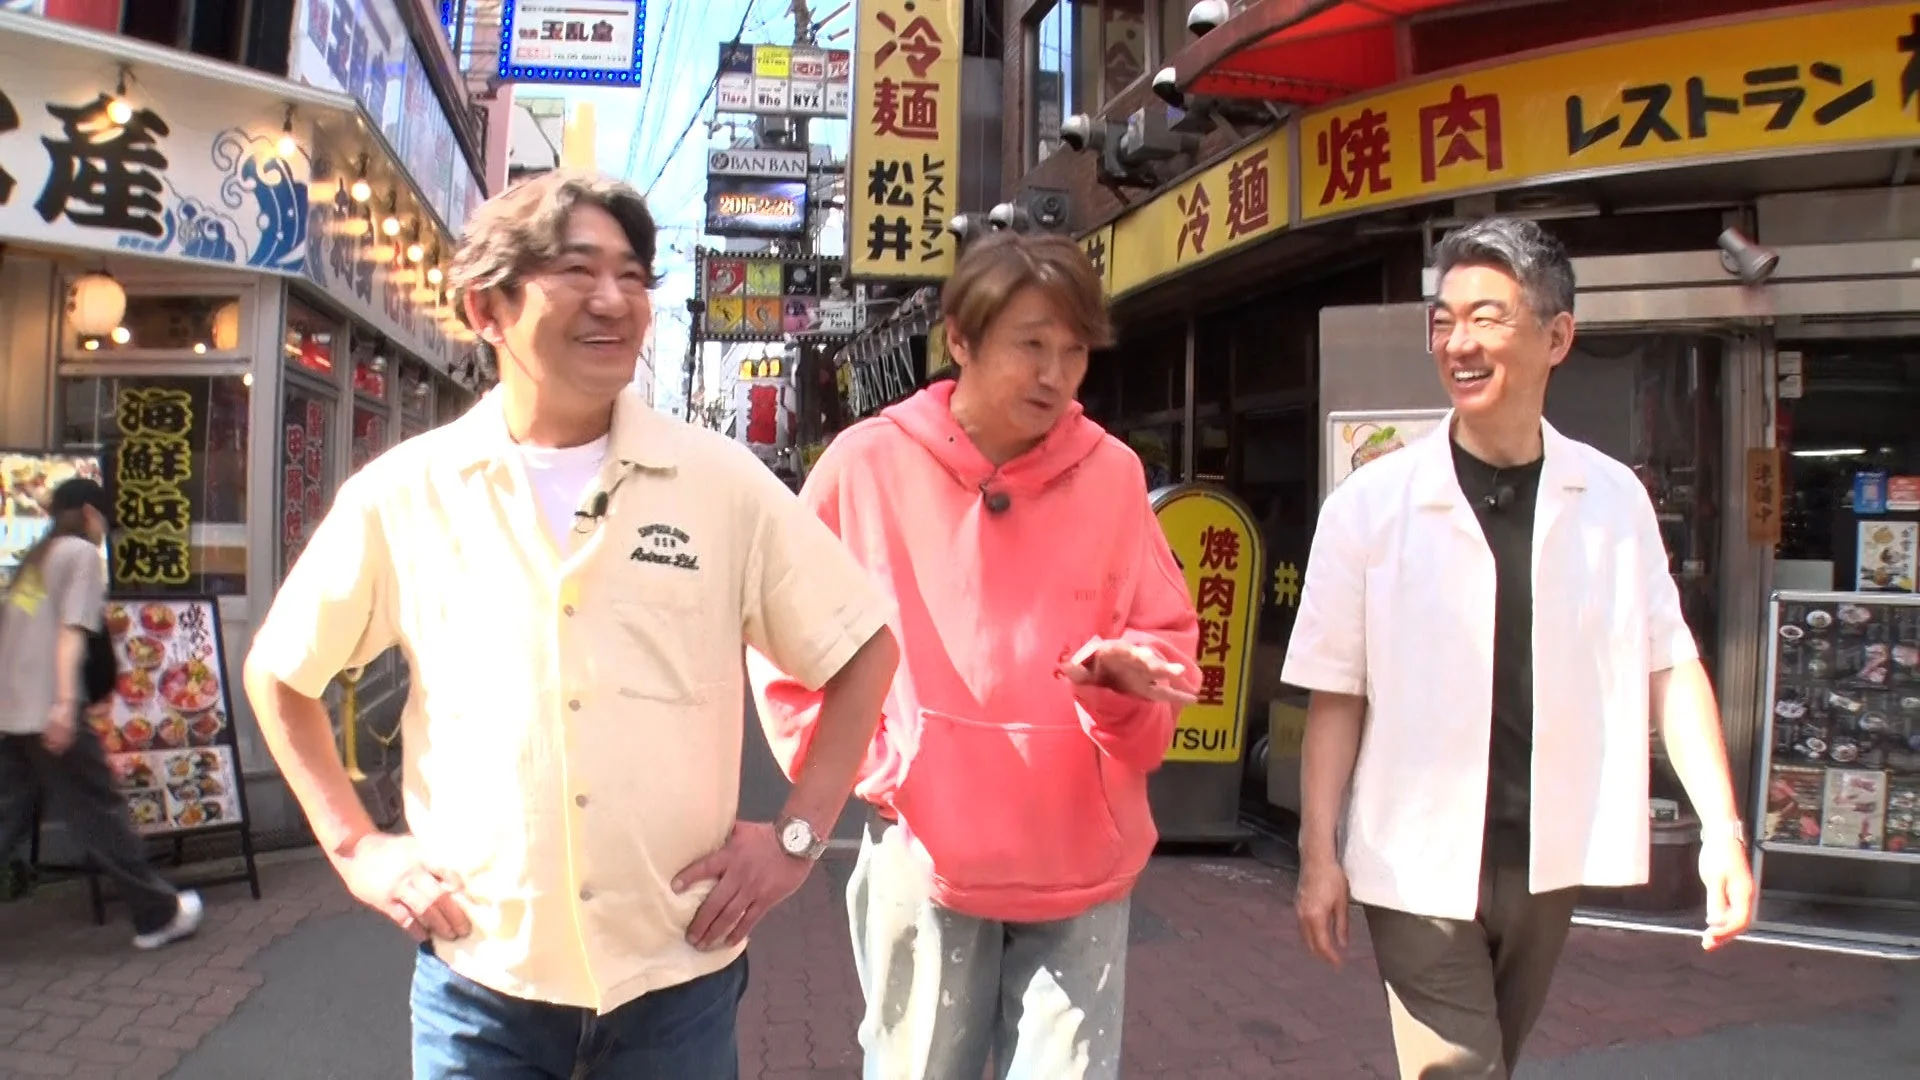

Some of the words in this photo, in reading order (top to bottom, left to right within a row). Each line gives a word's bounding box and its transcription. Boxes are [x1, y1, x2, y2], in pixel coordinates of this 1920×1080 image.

[793, 94, 819, 108] NYX
[1317, 84, 1503, 206] 焼肉
[1566, 61, 1875, 156] レストラン
[867, 159, 914, 262] 松井
[921, 153, 945, 262] レストラン
[1176, 148, 1270, 262] 冷麺
[1196, 525, 1240, 706] 焼肉料理
